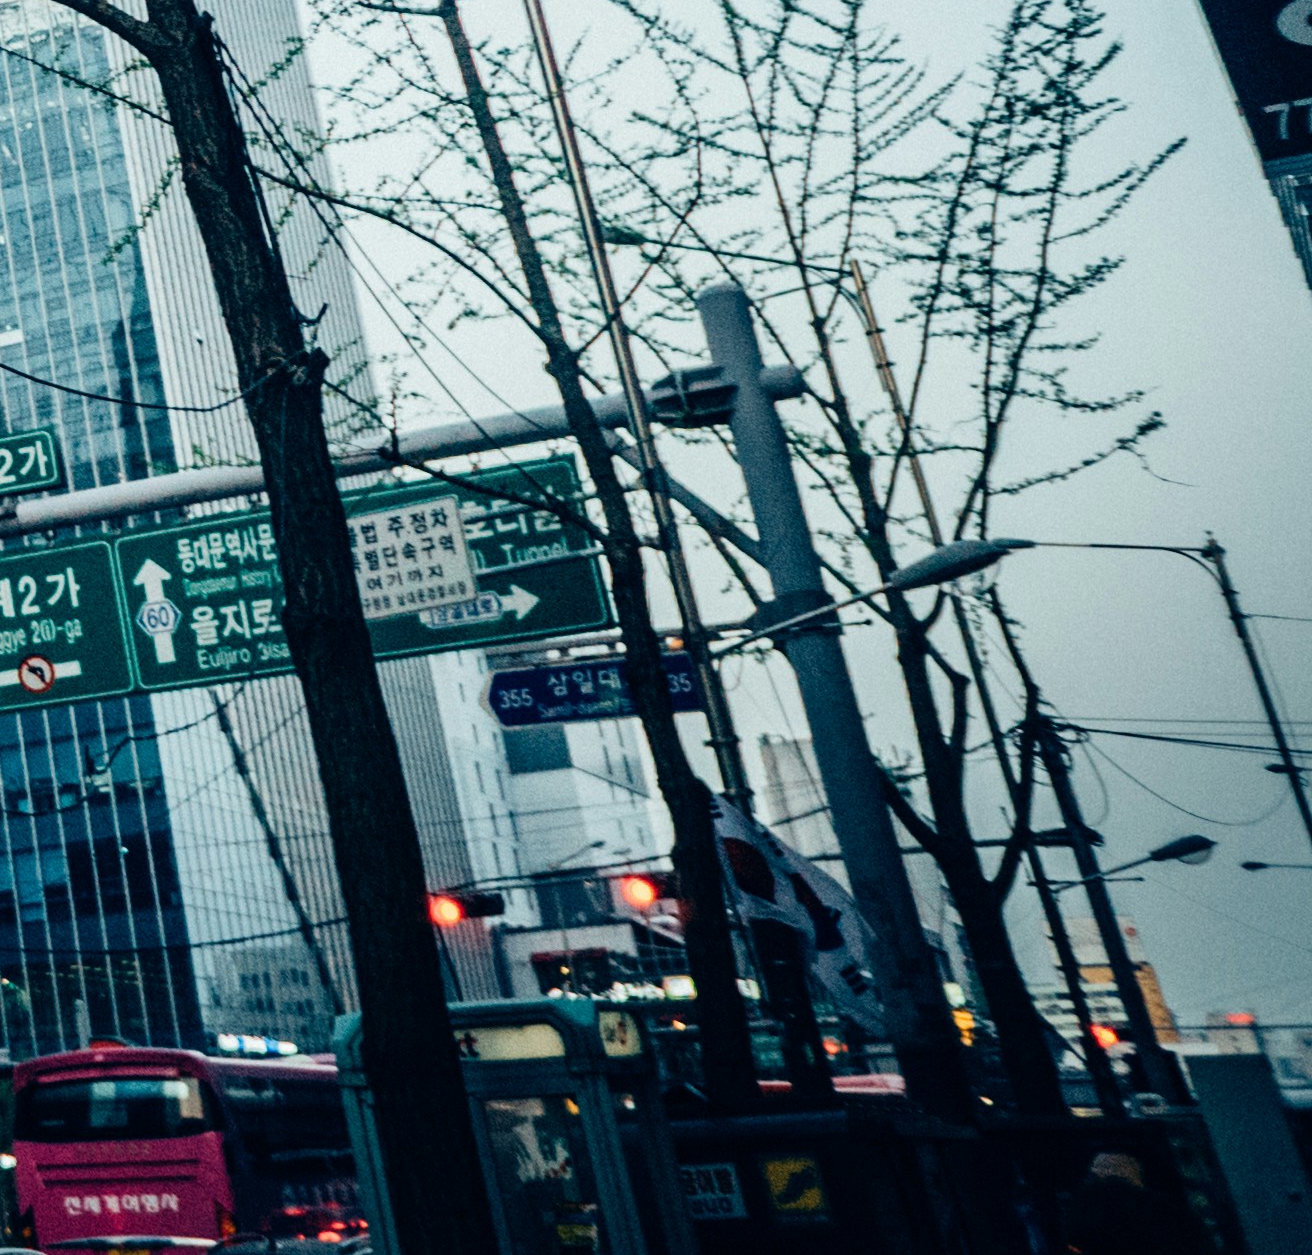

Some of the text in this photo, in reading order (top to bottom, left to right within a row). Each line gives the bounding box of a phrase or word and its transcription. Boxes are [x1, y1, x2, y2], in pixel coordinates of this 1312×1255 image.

[147, 608, 171, 629] 60
[191, 597, 287, 646] 을지로
[499, 688, 533, 709] 355
